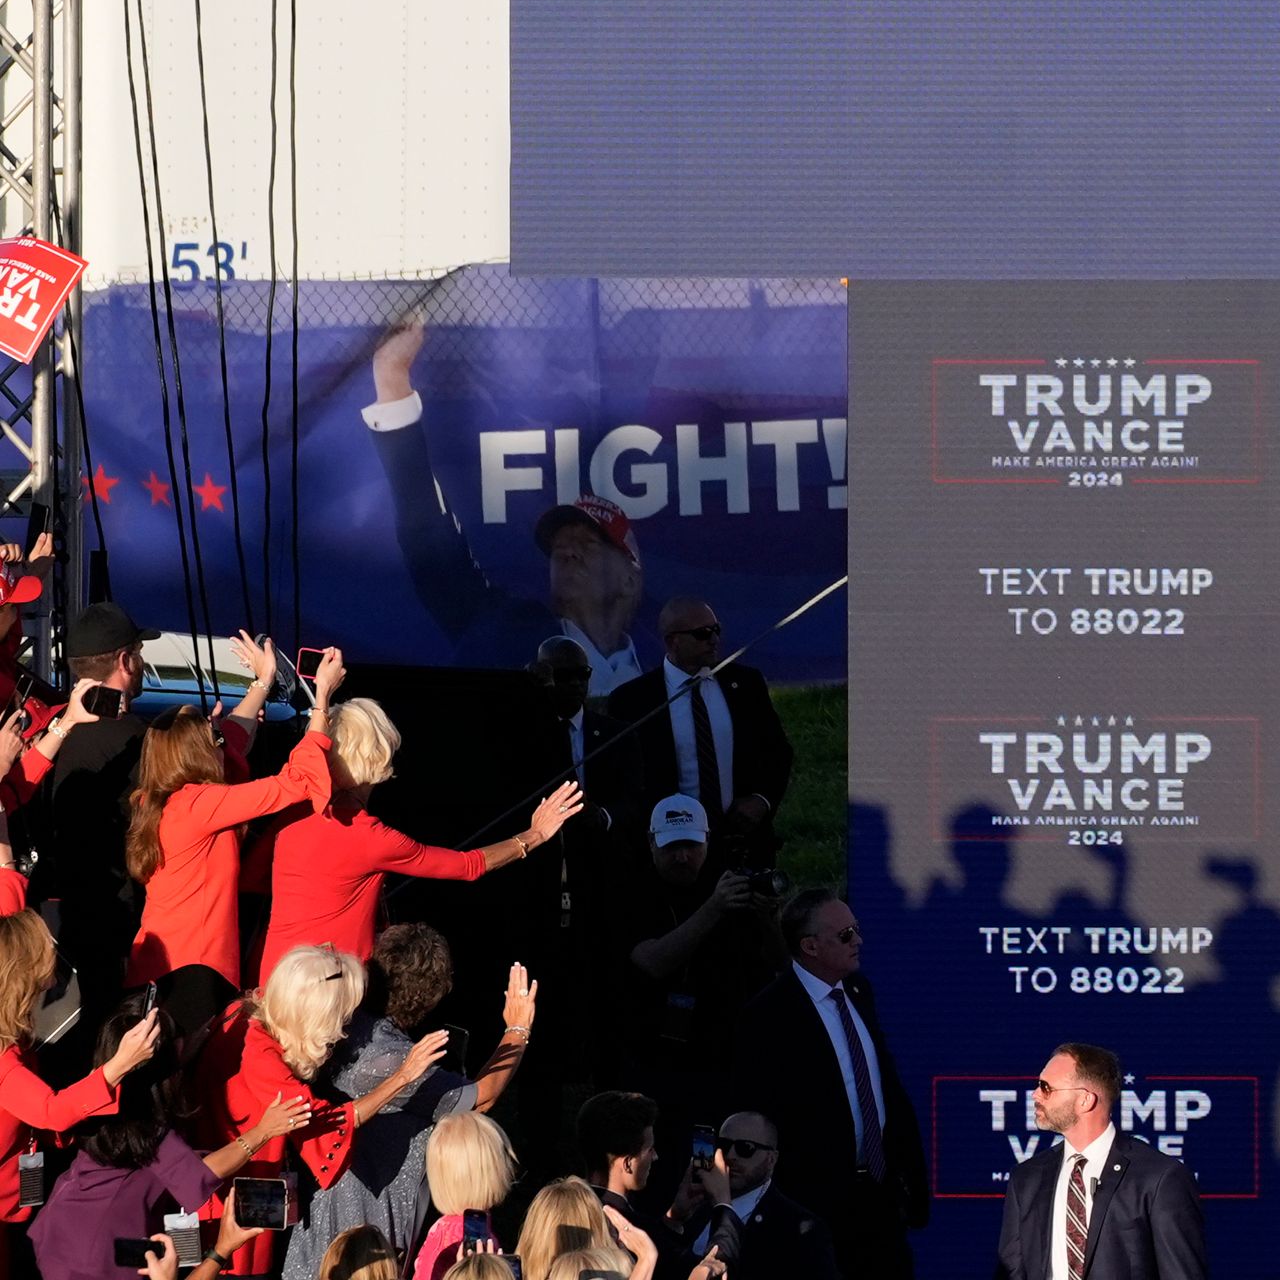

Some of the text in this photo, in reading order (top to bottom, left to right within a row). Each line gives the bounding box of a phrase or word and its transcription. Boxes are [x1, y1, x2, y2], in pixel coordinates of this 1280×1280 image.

[170, 241, 248, 291] 53'
[979, 374, 1212, 416] TRUMP
[1007, 419, 1185, 453] VANCE
[479, 418, 849, 524] FIGHT!
[991, 455, 1199, 468] MAKE AMERICA GREAT AGAIN!
[1068, 471, 1123, 488] 2024
[979, 567, 1213, 596] TEXT TRUMP
[1008, 607, 1185, 635] TO 88022
[979, 733, 1212, 774] TRUMP
[1007, 778, 1184, 811] VANCE
[991, 816, 1199, 826] MAKE AMERICA GREAT AGAIN!
[1068, 830, 1123, 846] 2024
[979, 927, 1213, 954] TEXT TRUMP
[1008, 967, 1185, 993] TO 88022
[979, 1090, 1212, 1132] TMP
